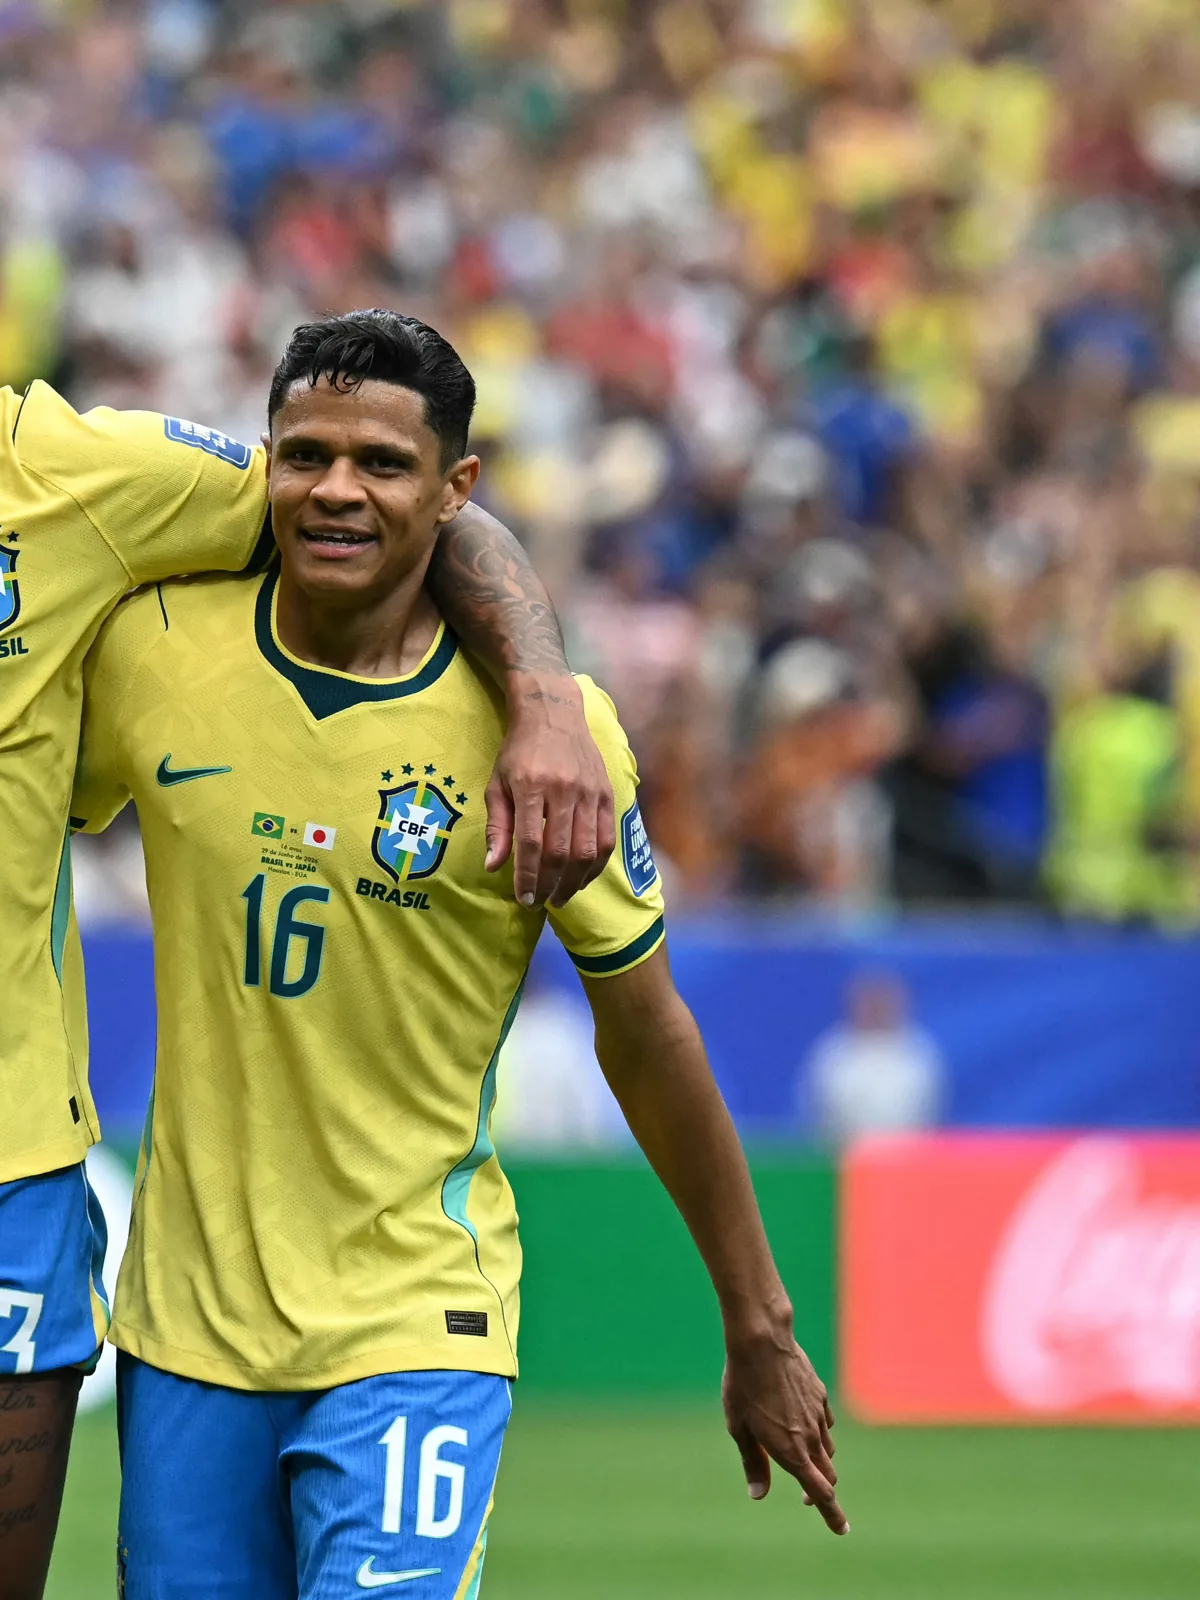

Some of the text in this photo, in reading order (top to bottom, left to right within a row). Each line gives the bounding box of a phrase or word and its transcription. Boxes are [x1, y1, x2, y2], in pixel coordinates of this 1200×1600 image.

[398, 820, 429, 838] CBF
[294, 862, 317, 873] JAPÃO
[304, 856, 318, 864] 2026
[268, 866, 290, 876] Houston
[355, 877, 431, 911] BRASIL
[241, 873, 331, 1000] 16
[377, 1415, 468, 1539] 16
